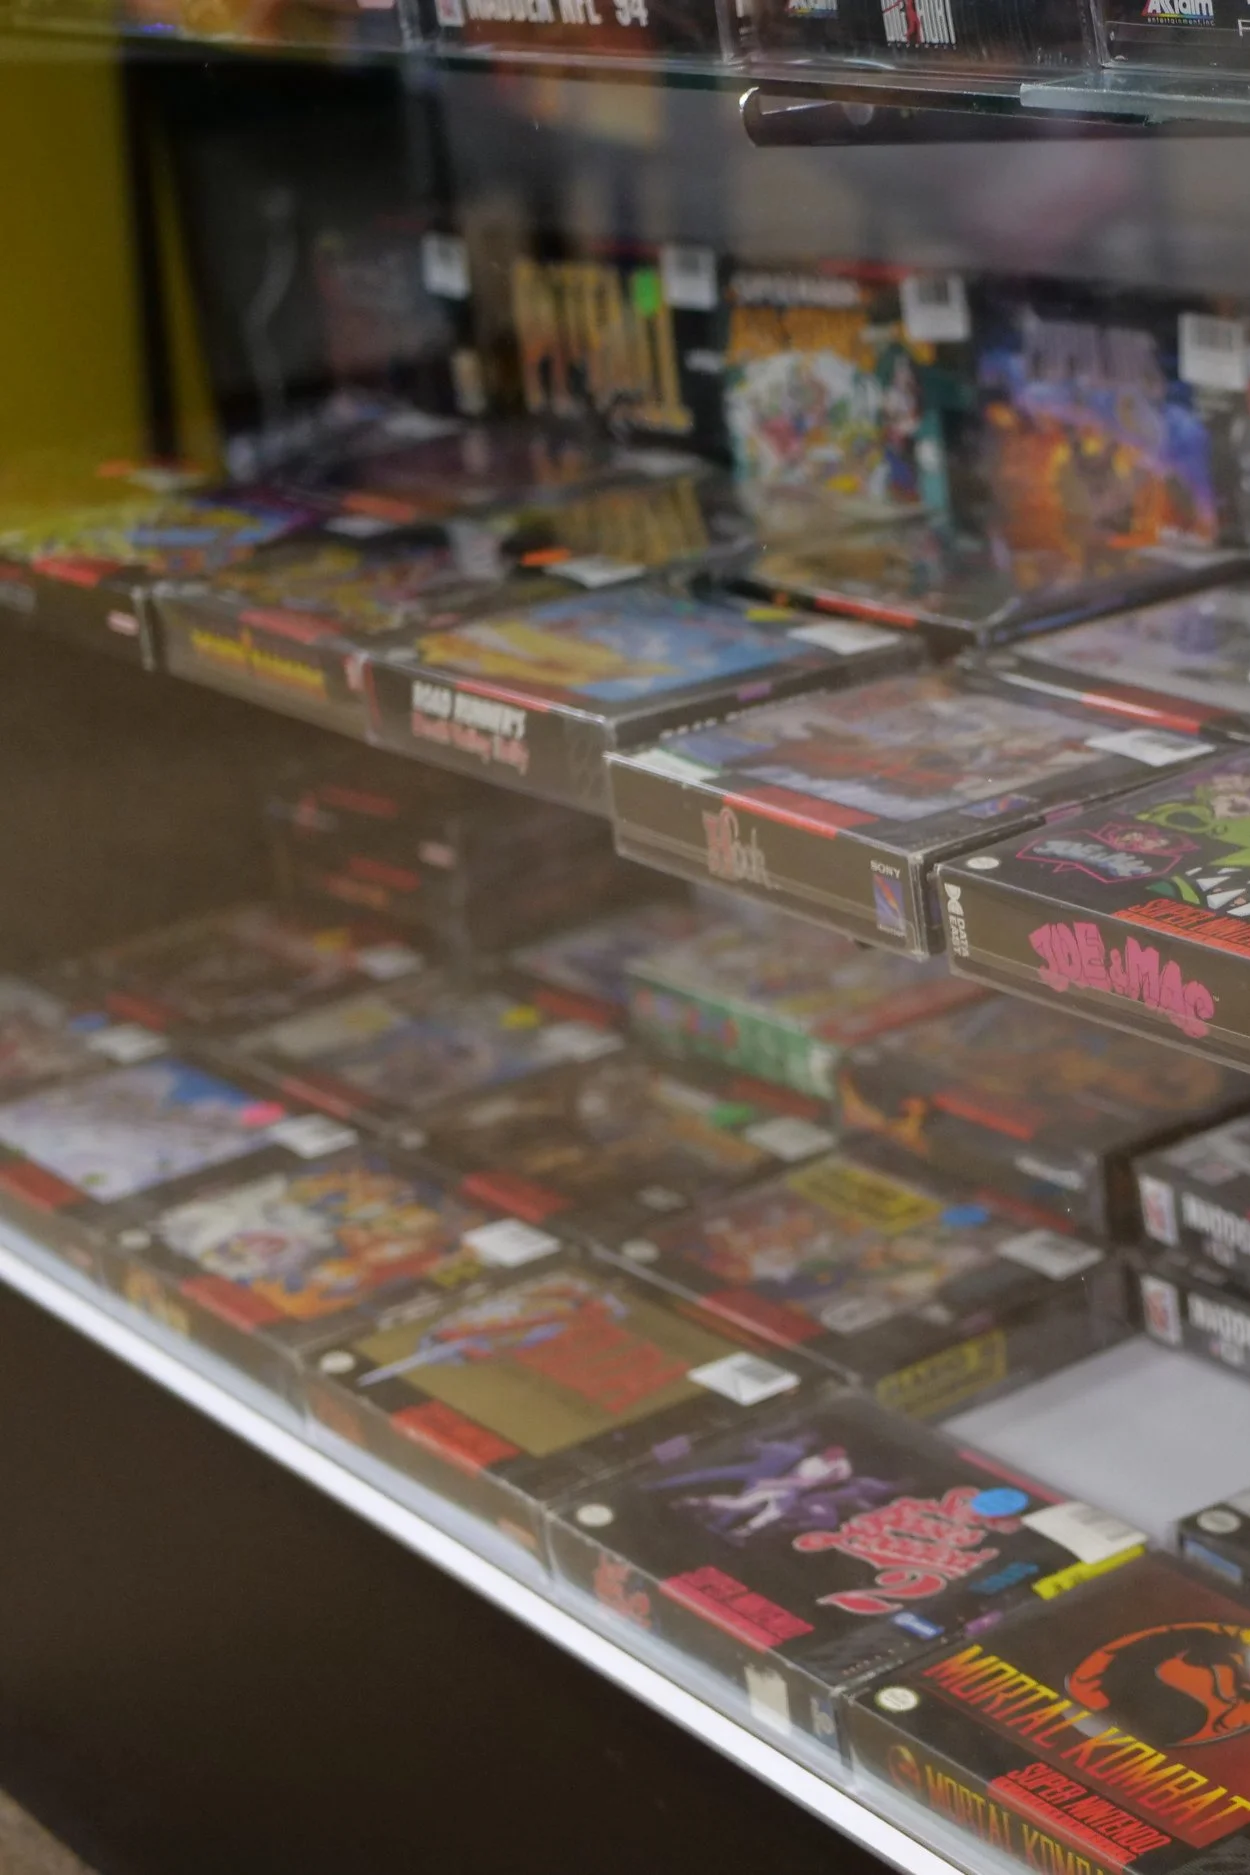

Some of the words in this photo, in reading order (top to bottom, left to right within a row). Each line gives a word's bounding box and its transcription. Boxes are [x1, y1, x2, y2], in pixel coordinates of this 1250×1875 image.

[870, 859, 902, 879] SONY
[1028, 921, 1112, 993] JOE
[1125, 935, 1215, 1039] MAC
[921, 1643, 1093, 1750] MORTAL
[923, 1763, 1013, 1856] MORTAL
[1021, 1824, 1105, 1875] KOMB
[1008, 1761, 1082, 1807] SUPER
[1062, 1787, 1173, 1856] NINTENDO
